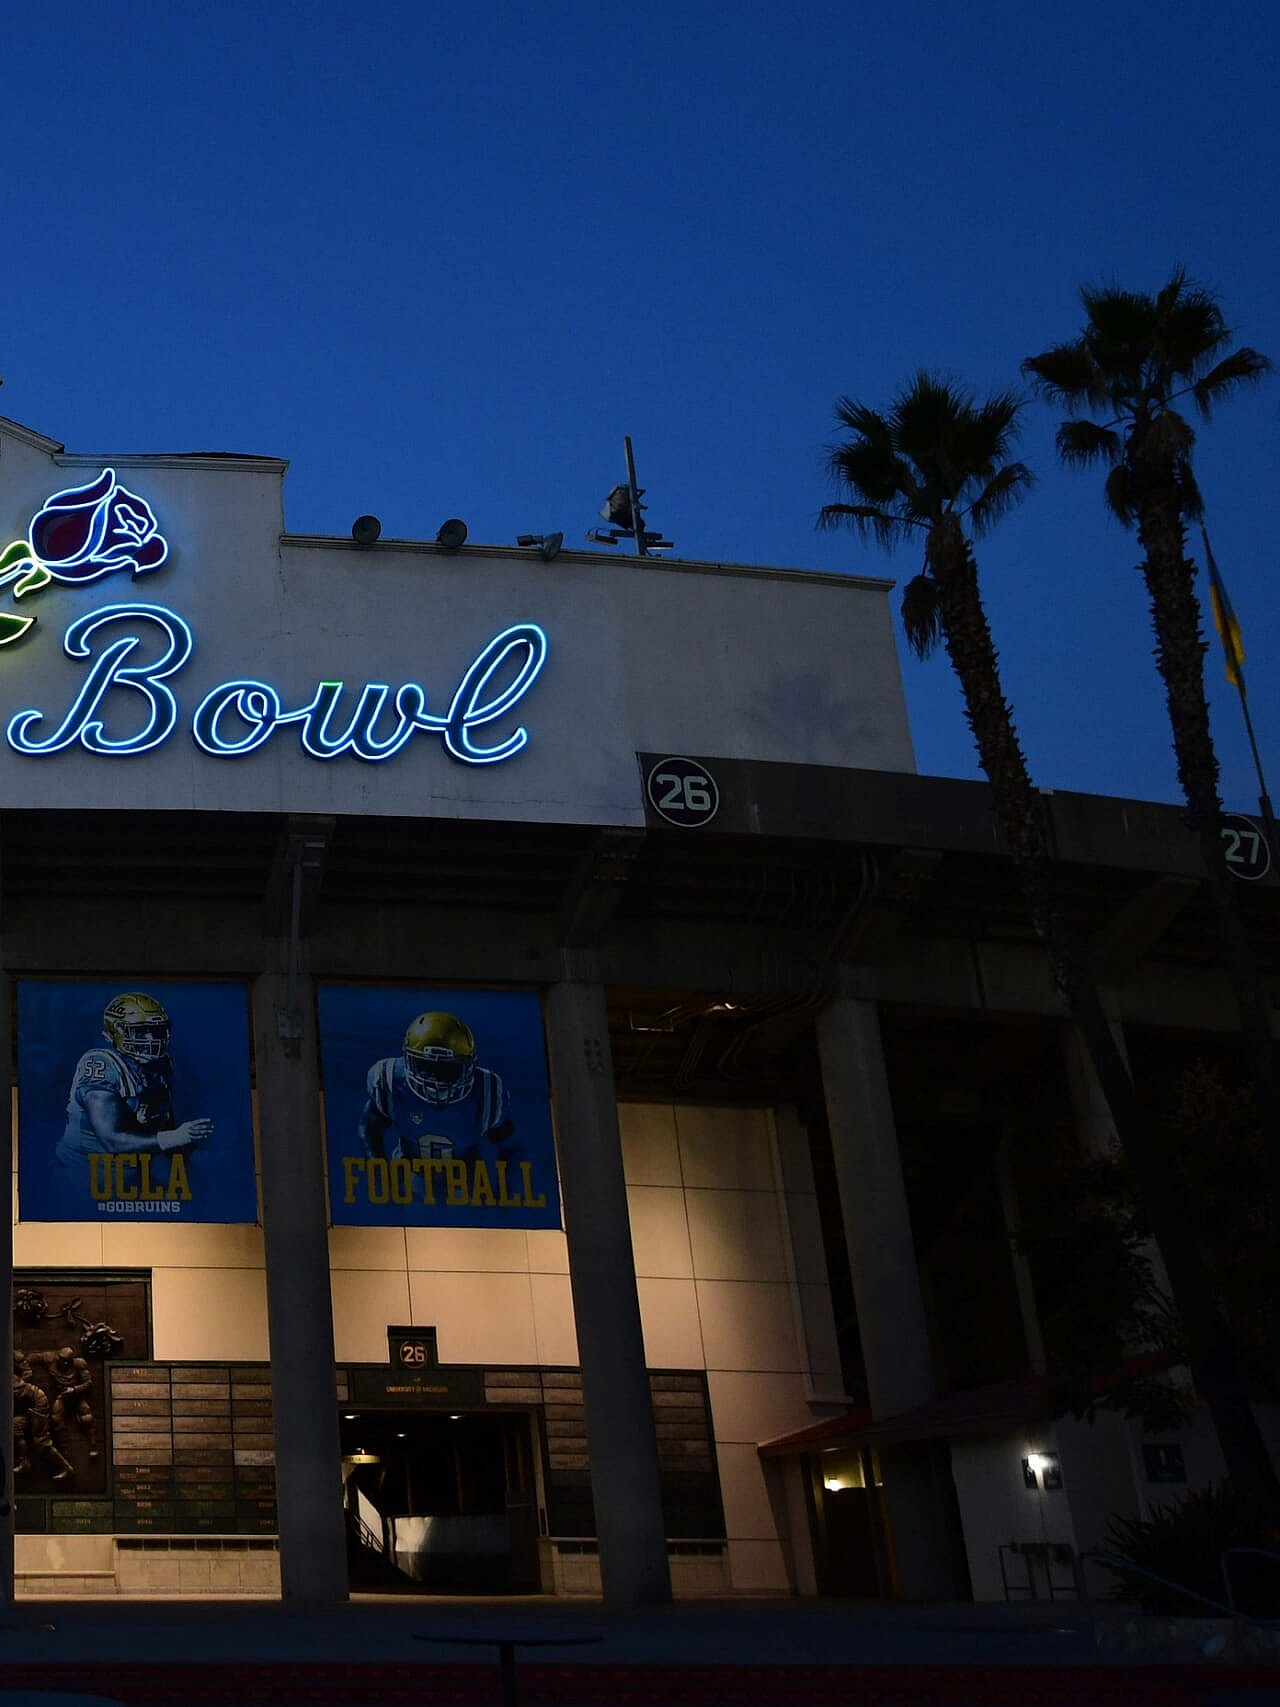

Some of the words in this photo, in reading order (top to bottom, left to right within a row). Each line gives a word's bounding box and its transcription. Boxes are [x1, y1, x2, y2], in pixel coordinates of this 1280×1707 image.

[6, 603, 548, 766] Bowl
[655, 773, 712, 811] 26
[1220, 827, 1260, 865] 27
[88, 1153, 192, 1201] UCLA
[342, 1157, 547, 1208] FOOTBALL
[97, 1201, 181, 1213] #GOBRUINS
[403, 1346, 425, 1363] 26
